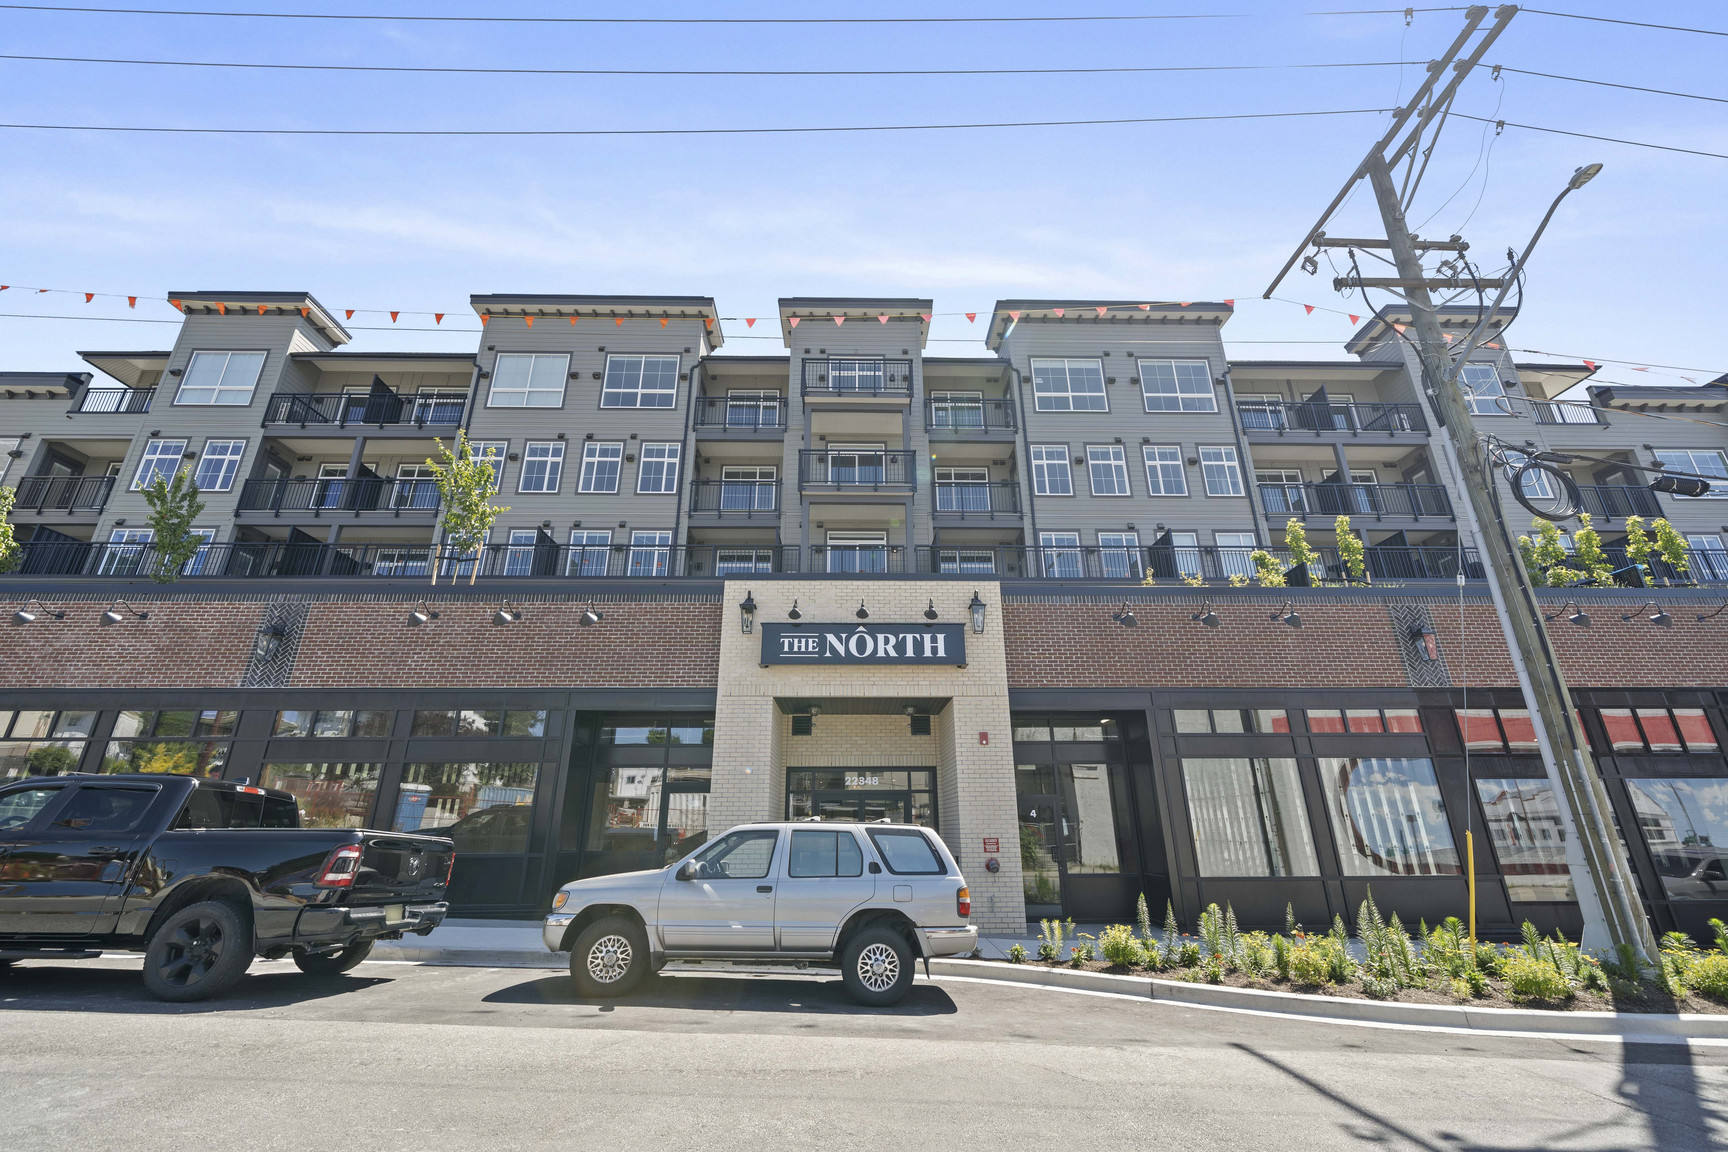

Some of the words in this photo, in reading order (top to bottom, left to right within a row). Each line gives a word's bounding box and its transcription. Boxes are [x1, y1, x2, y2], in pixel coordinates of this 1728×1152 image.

[780, 638, 819, 652] THE
[844, 776, 879, 786] 22348
[1030, 809, 1037, 818] 4
